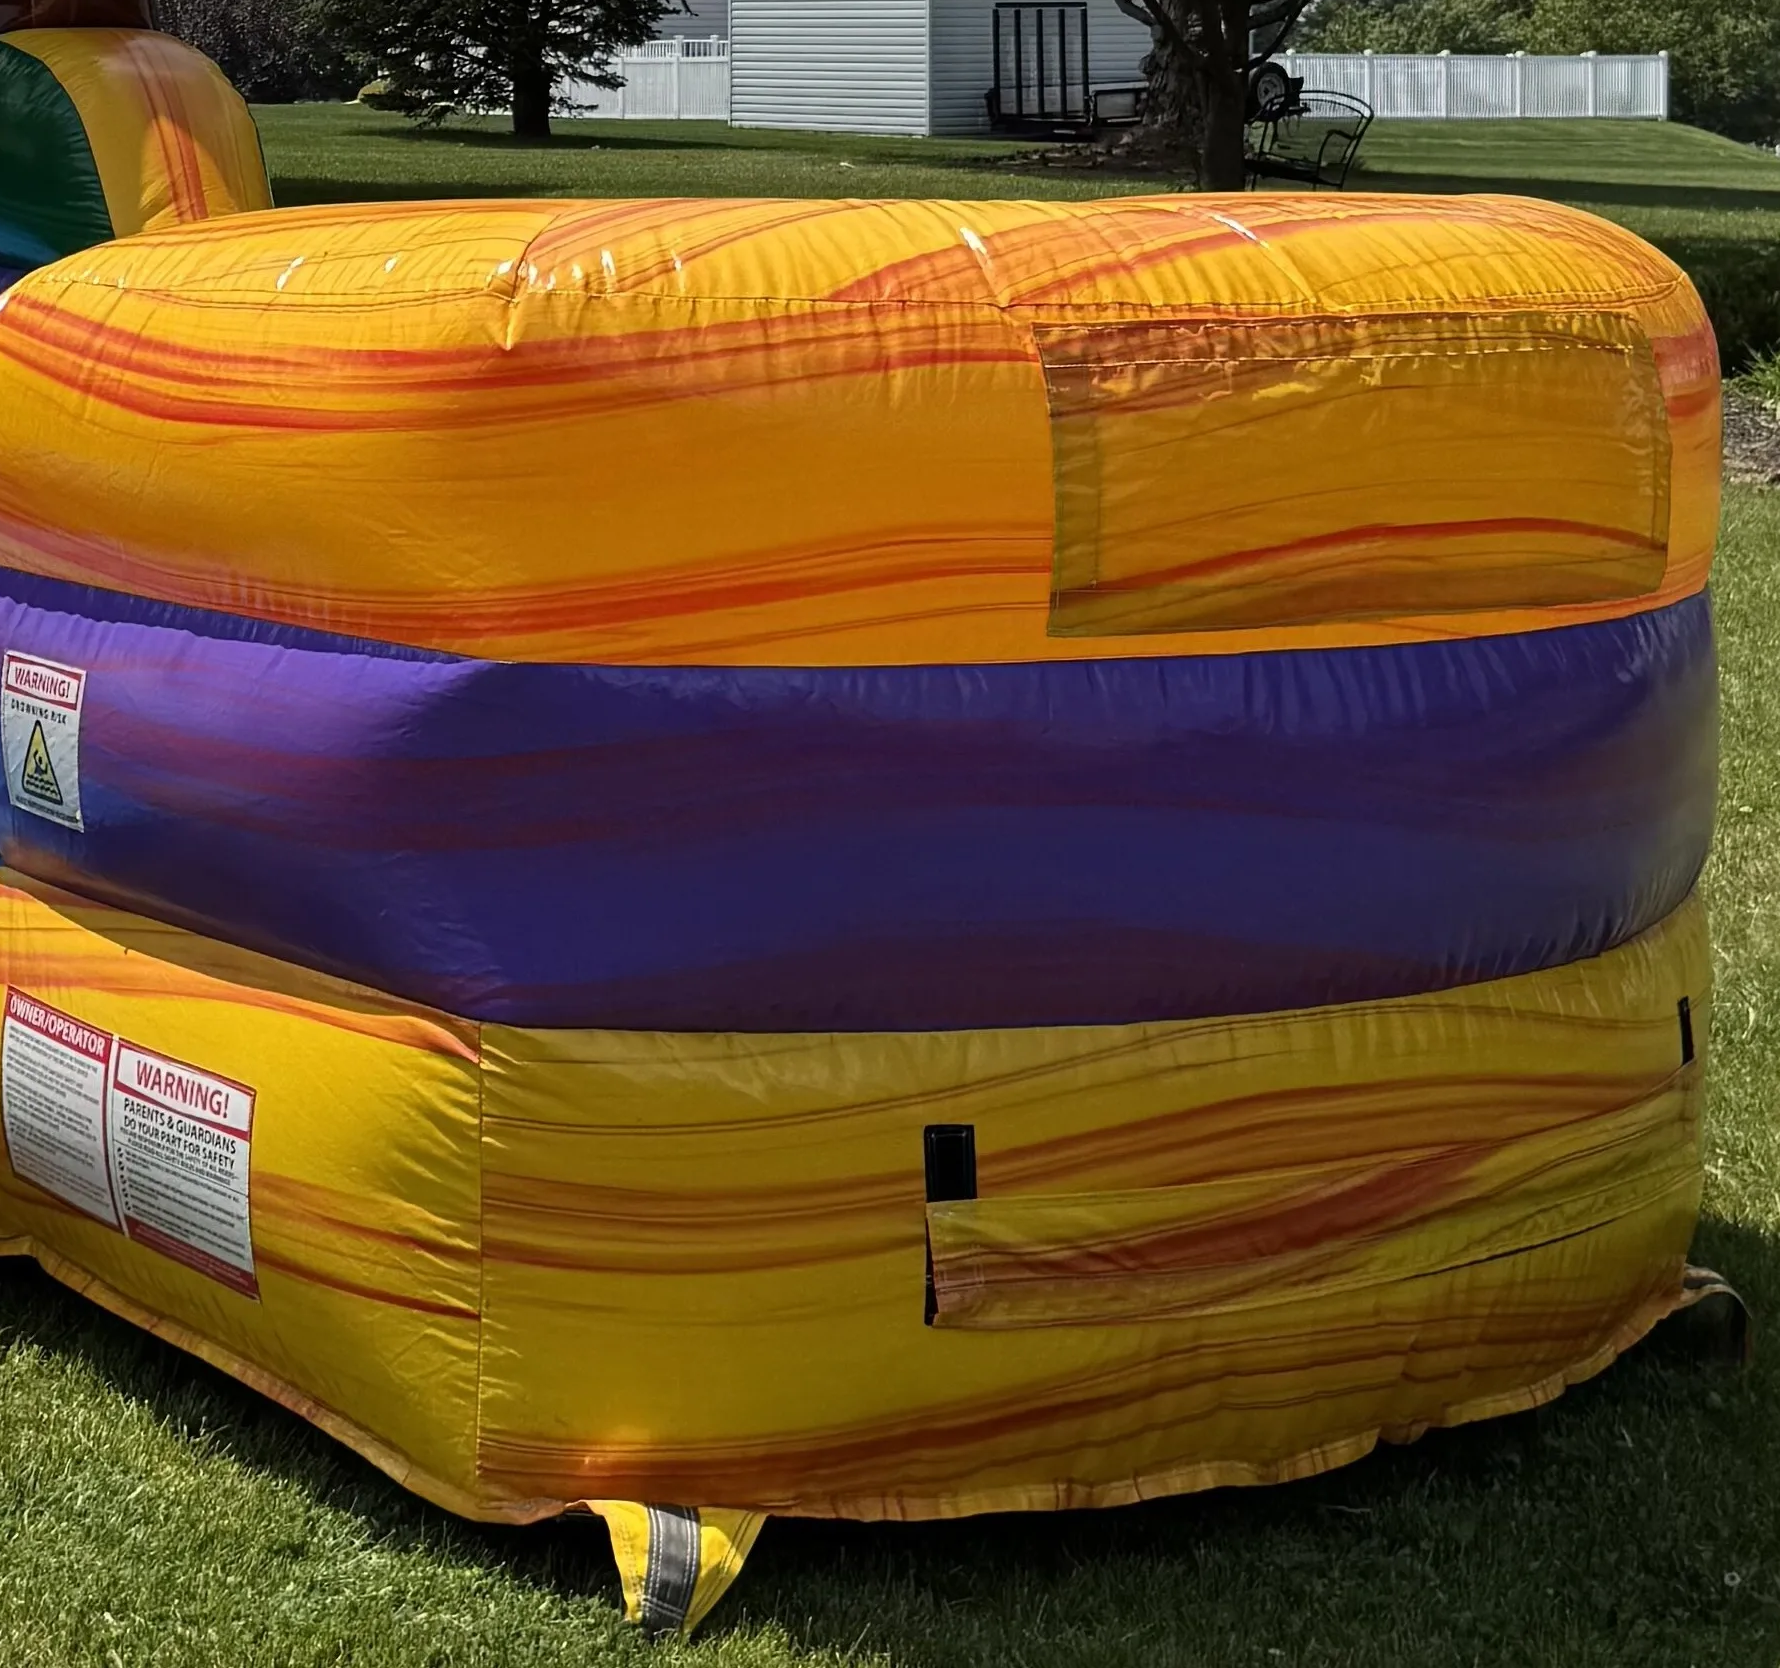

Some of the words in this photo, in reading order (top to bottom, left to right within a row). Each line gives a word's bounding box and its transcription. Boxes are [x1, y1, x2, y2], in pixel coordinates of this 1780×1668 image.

[14, 667, 71, 698] WARNING!
[10, 995, 105, 1057] OWNER/OPERATOR
[137, 1060, 229, 1119] WARNING!
[124, 1098, 165, 1125] PARENTS
[167, 1116, 174, 1129] &
[176, 1120, 236, 1154] GUARDIANS
[124, 1116, 136, 1129] DO
[139, 1121, 160, 1140] YOUR
[161, 1133, 182, 1149] PART
[184, 1140, 200, 1155] FOR
[203, 1147, 235, 1170] SAFETY
